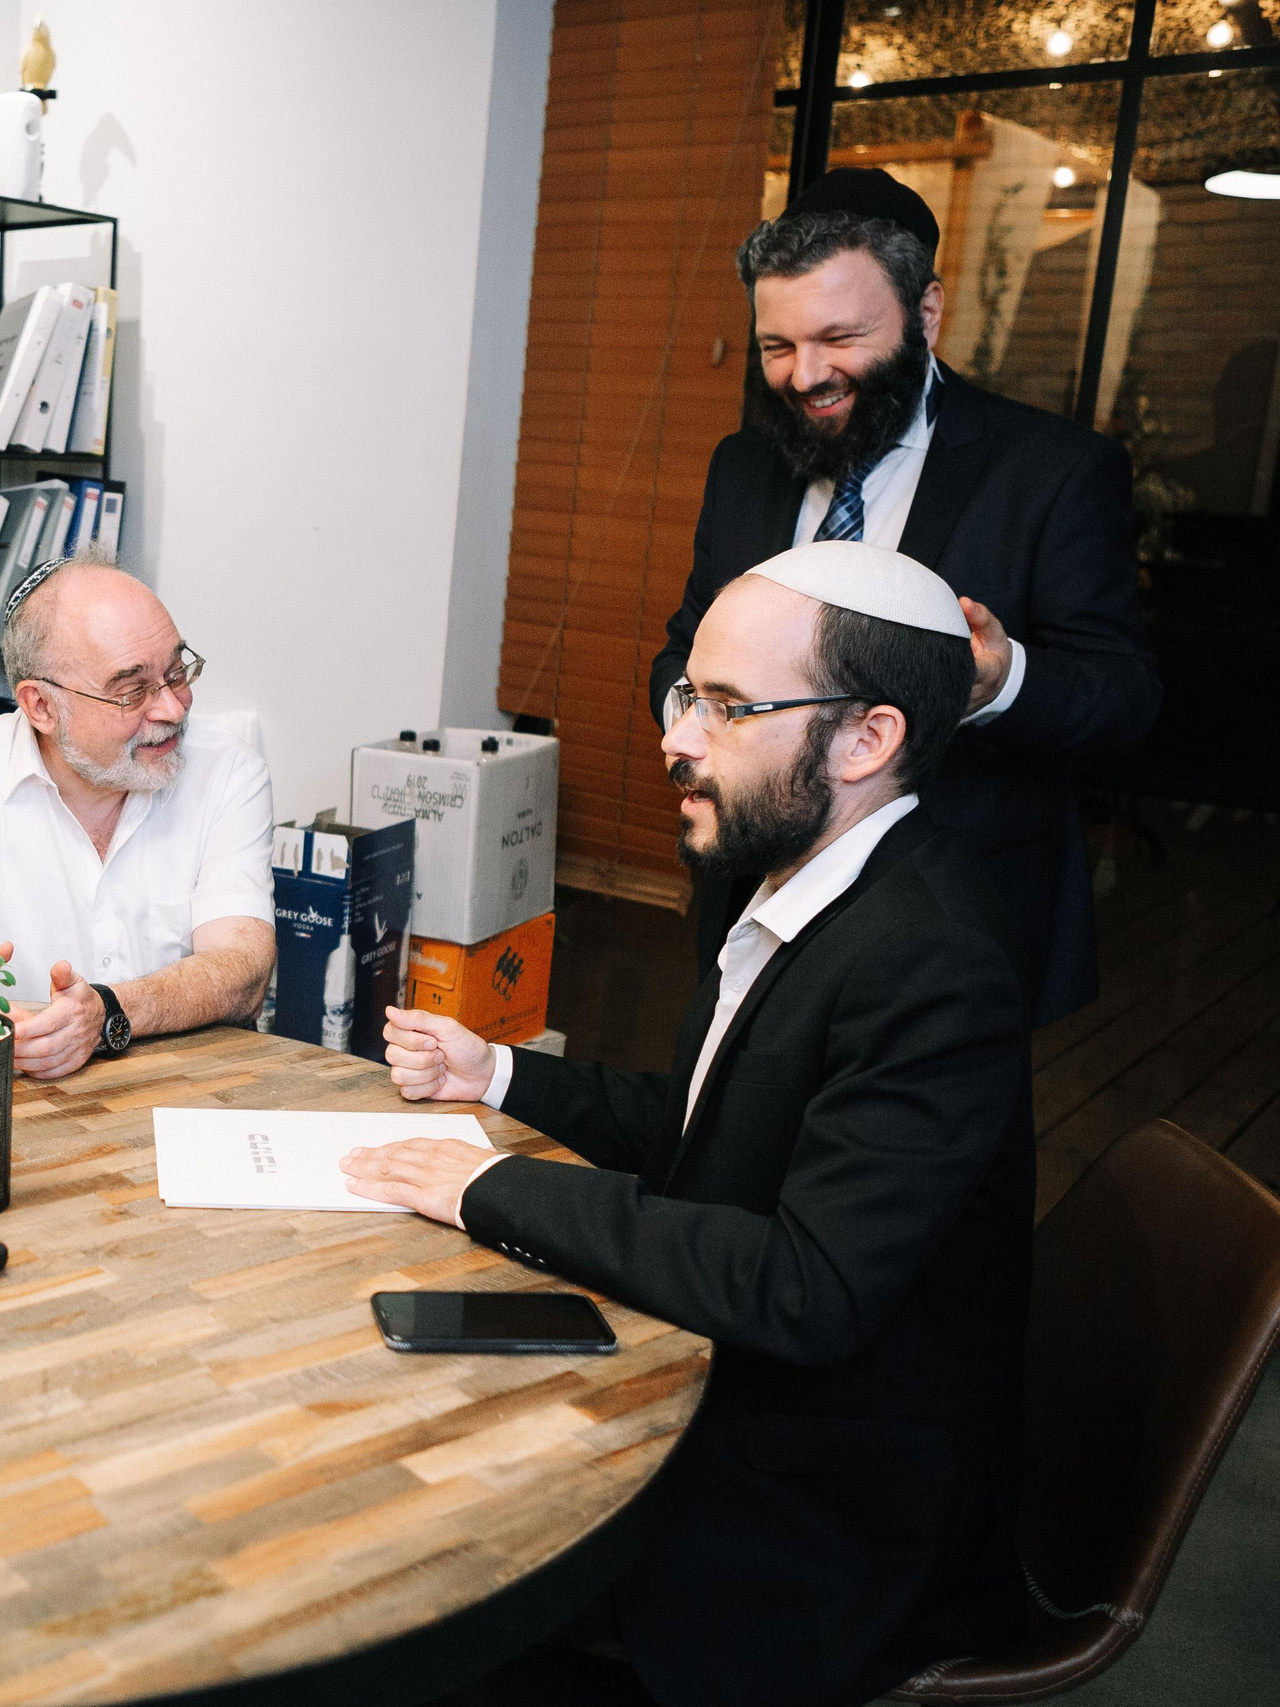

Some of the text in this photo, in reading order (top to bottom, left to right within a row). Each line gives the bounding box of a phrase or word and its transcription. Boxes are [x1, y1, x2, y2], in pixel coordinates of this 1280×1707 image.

[406, 774, 428, 789] 2019
[417, 790, 464, 808] CRIMSON
[414, 807, 444, 822] ALMA
[501, 820, 543, 849] DALTON
[275, 908, 333, 927] GREY GOOSE
